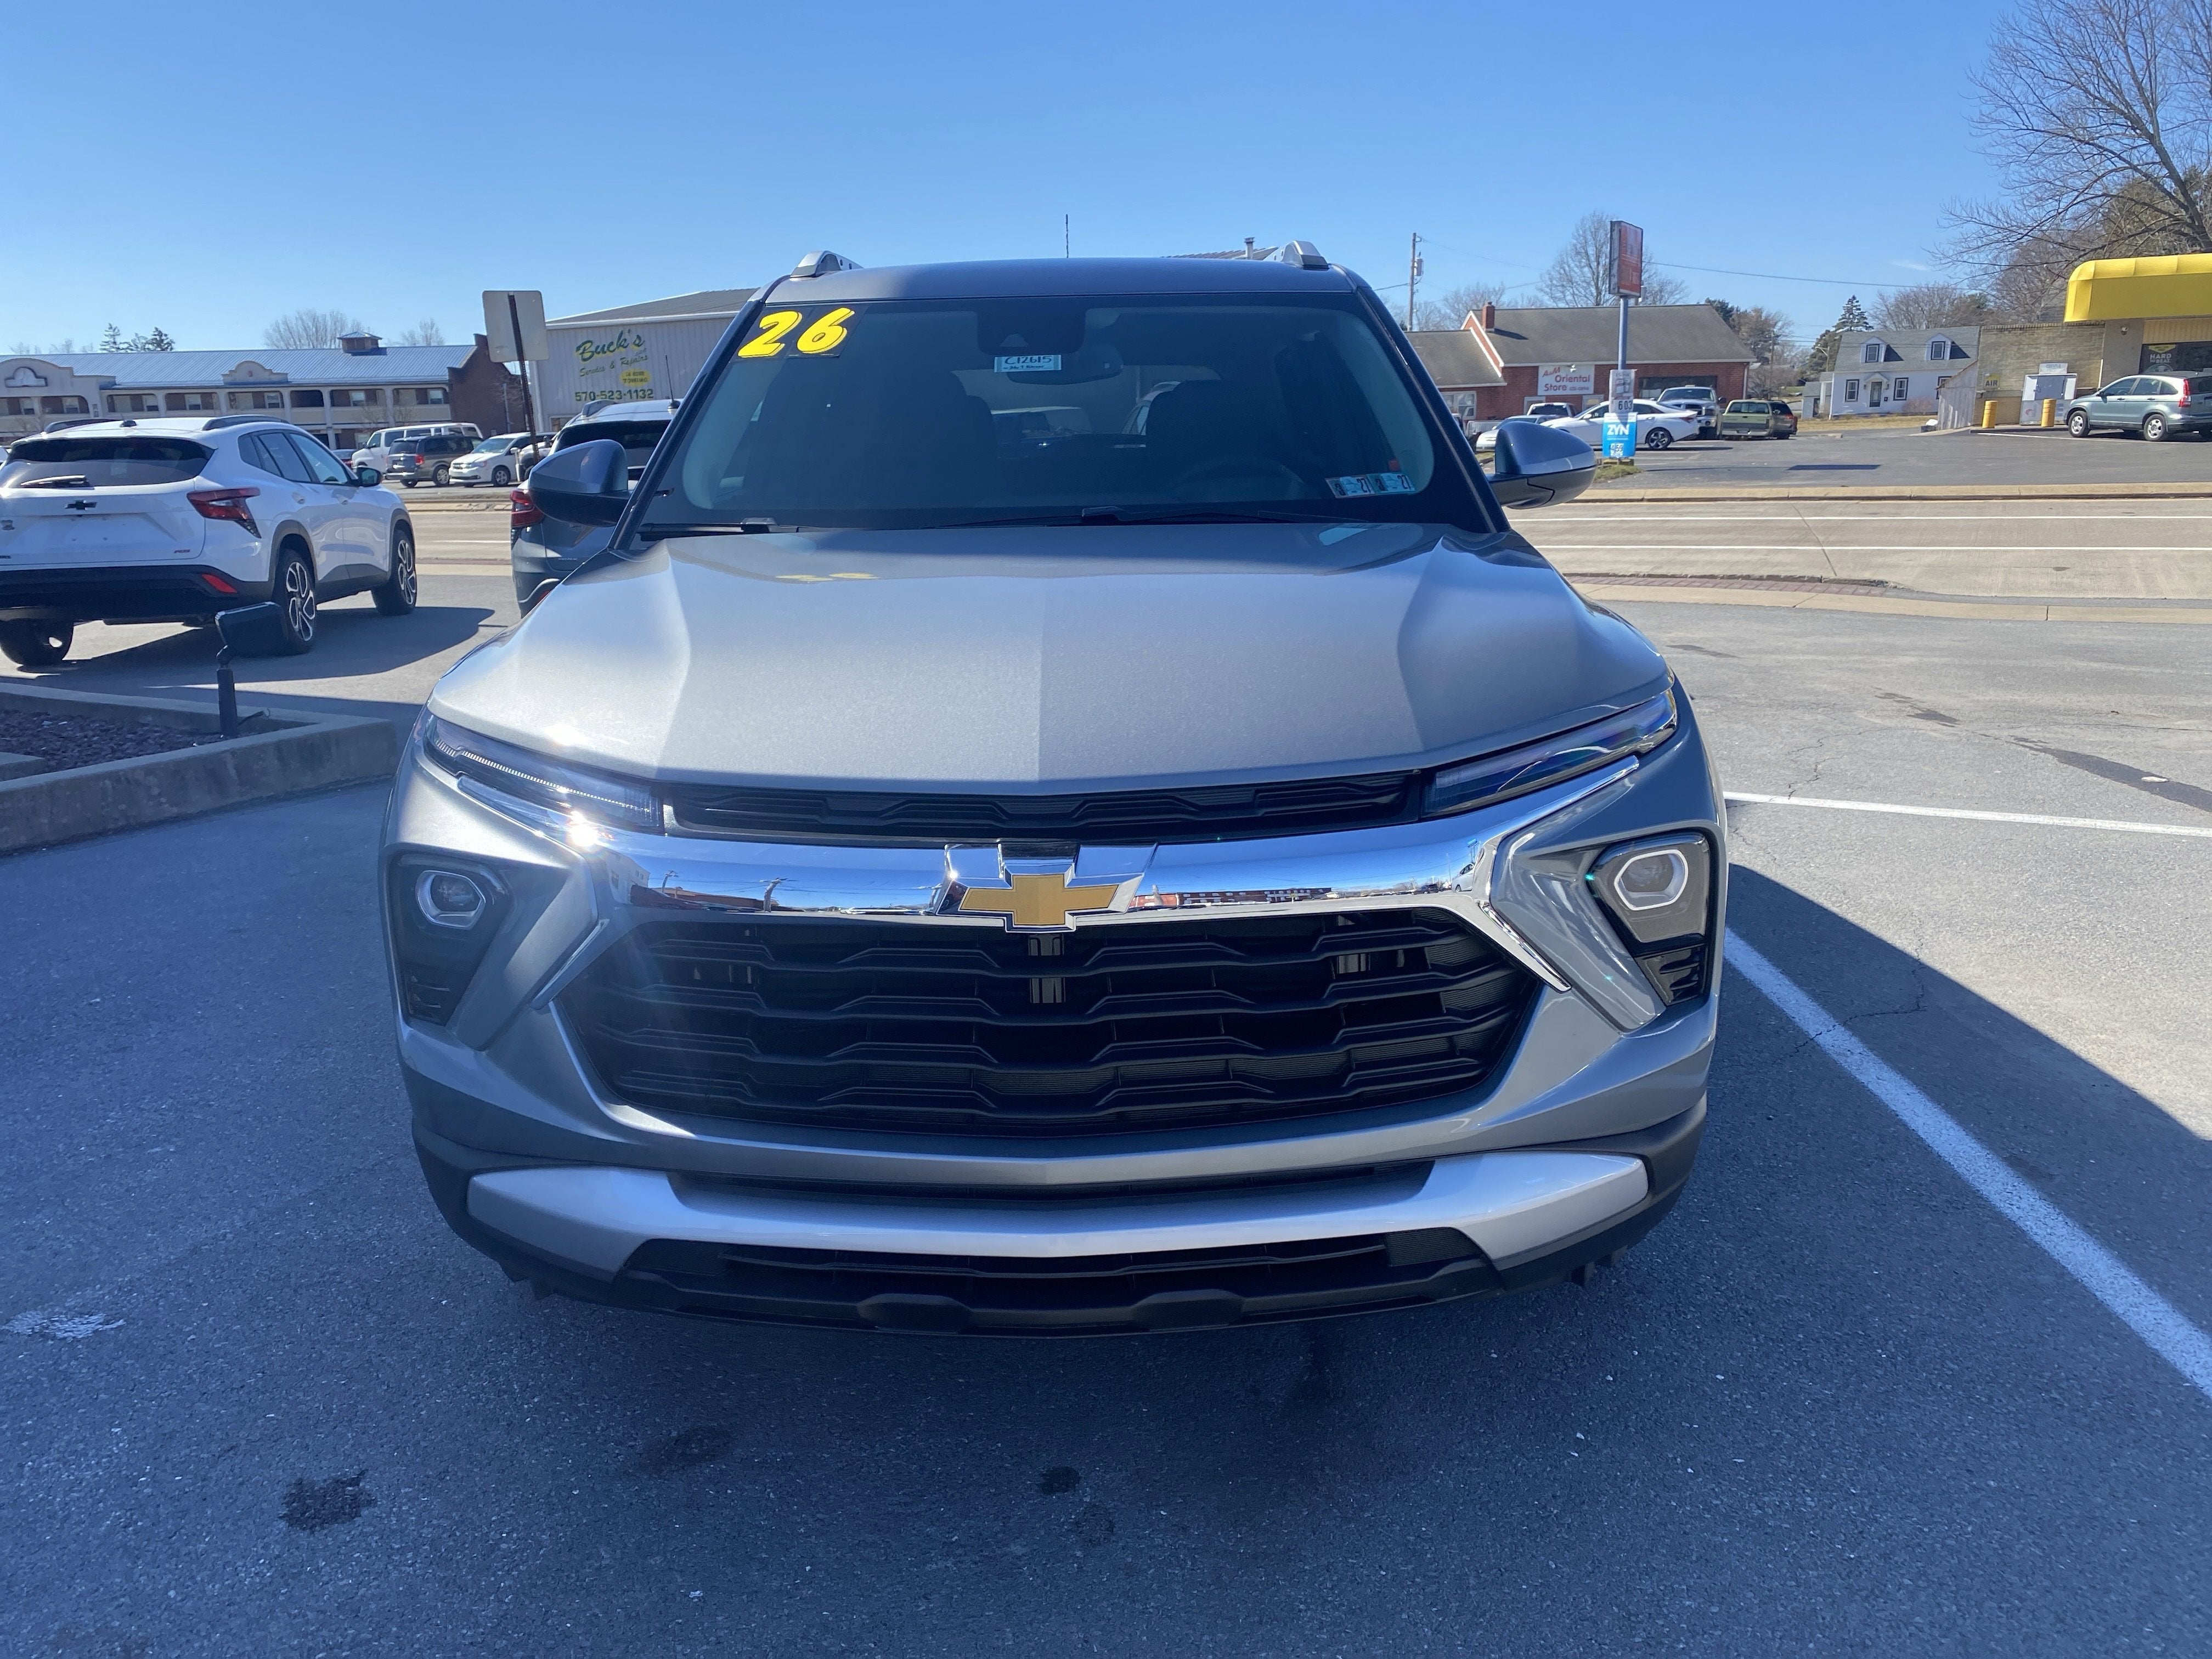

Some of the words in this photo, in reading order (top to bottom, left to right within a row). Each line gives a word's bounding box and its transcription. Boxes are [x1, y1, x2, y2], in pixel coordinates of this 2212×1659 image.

[738, 307, 855, 358] 26
[575, 329, 645, 362] Buck's
[580, 366, 605, 377] Service
[620, 355, 648, 366] Repairs
[575, 388, 654, 402] 570-523-1132
[1607, 424, 1629, 436] ZYN
